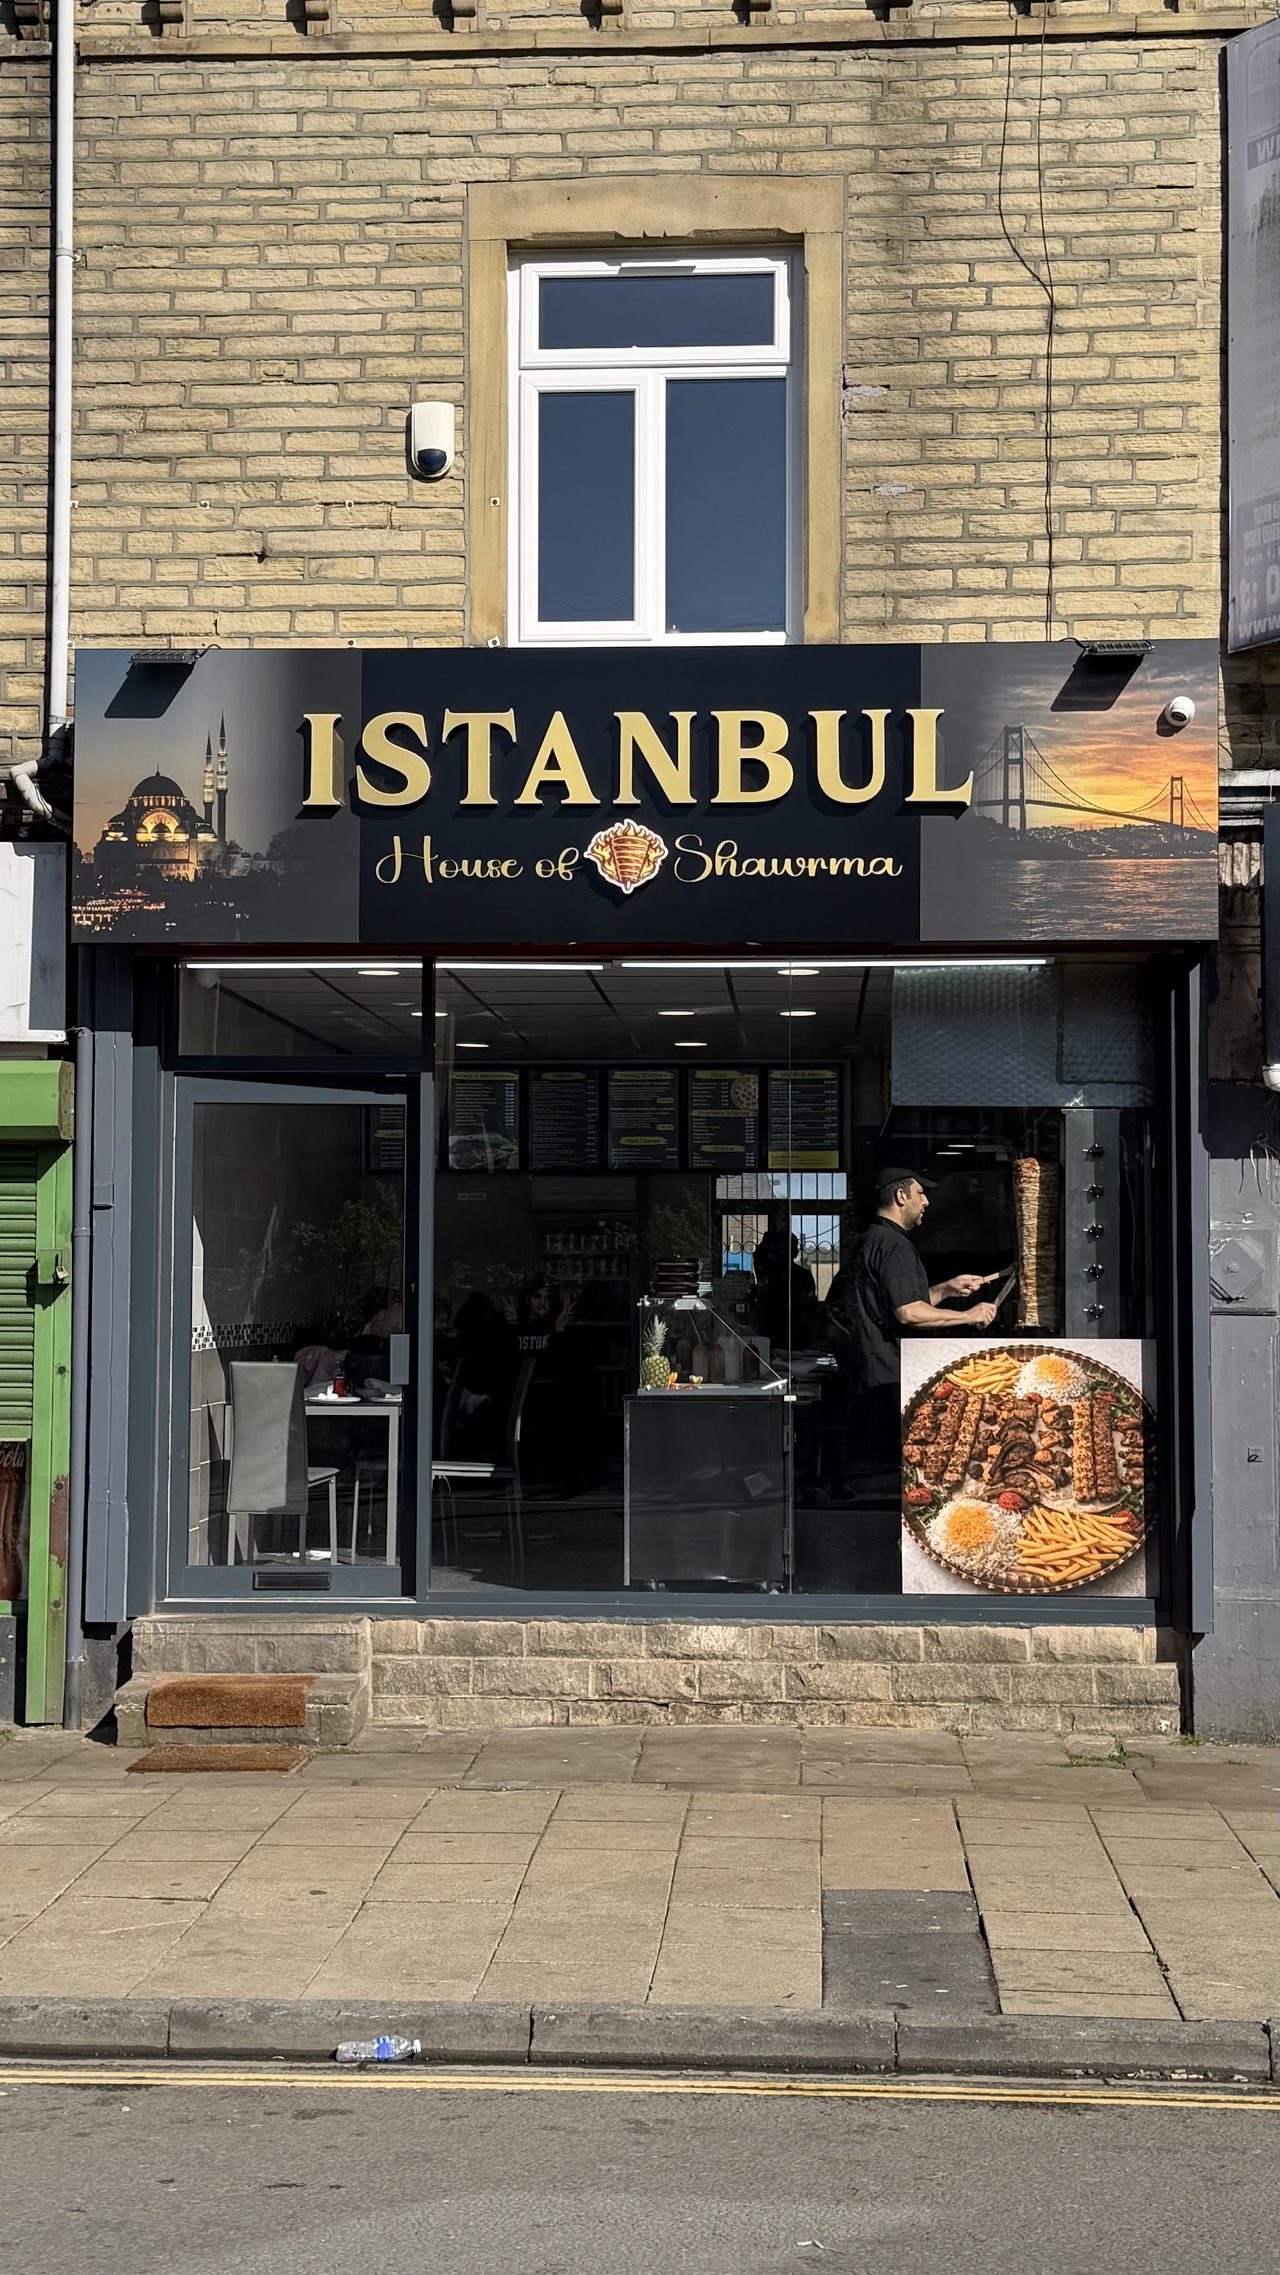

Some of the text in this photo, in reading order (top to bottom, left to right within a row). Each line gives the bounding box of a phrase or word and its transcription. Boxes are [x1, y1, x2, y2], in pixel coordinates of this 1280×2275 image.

[301, 707, 975, 808] ISTANBUL
[376, 834, 903, 884] House of Shawrma
